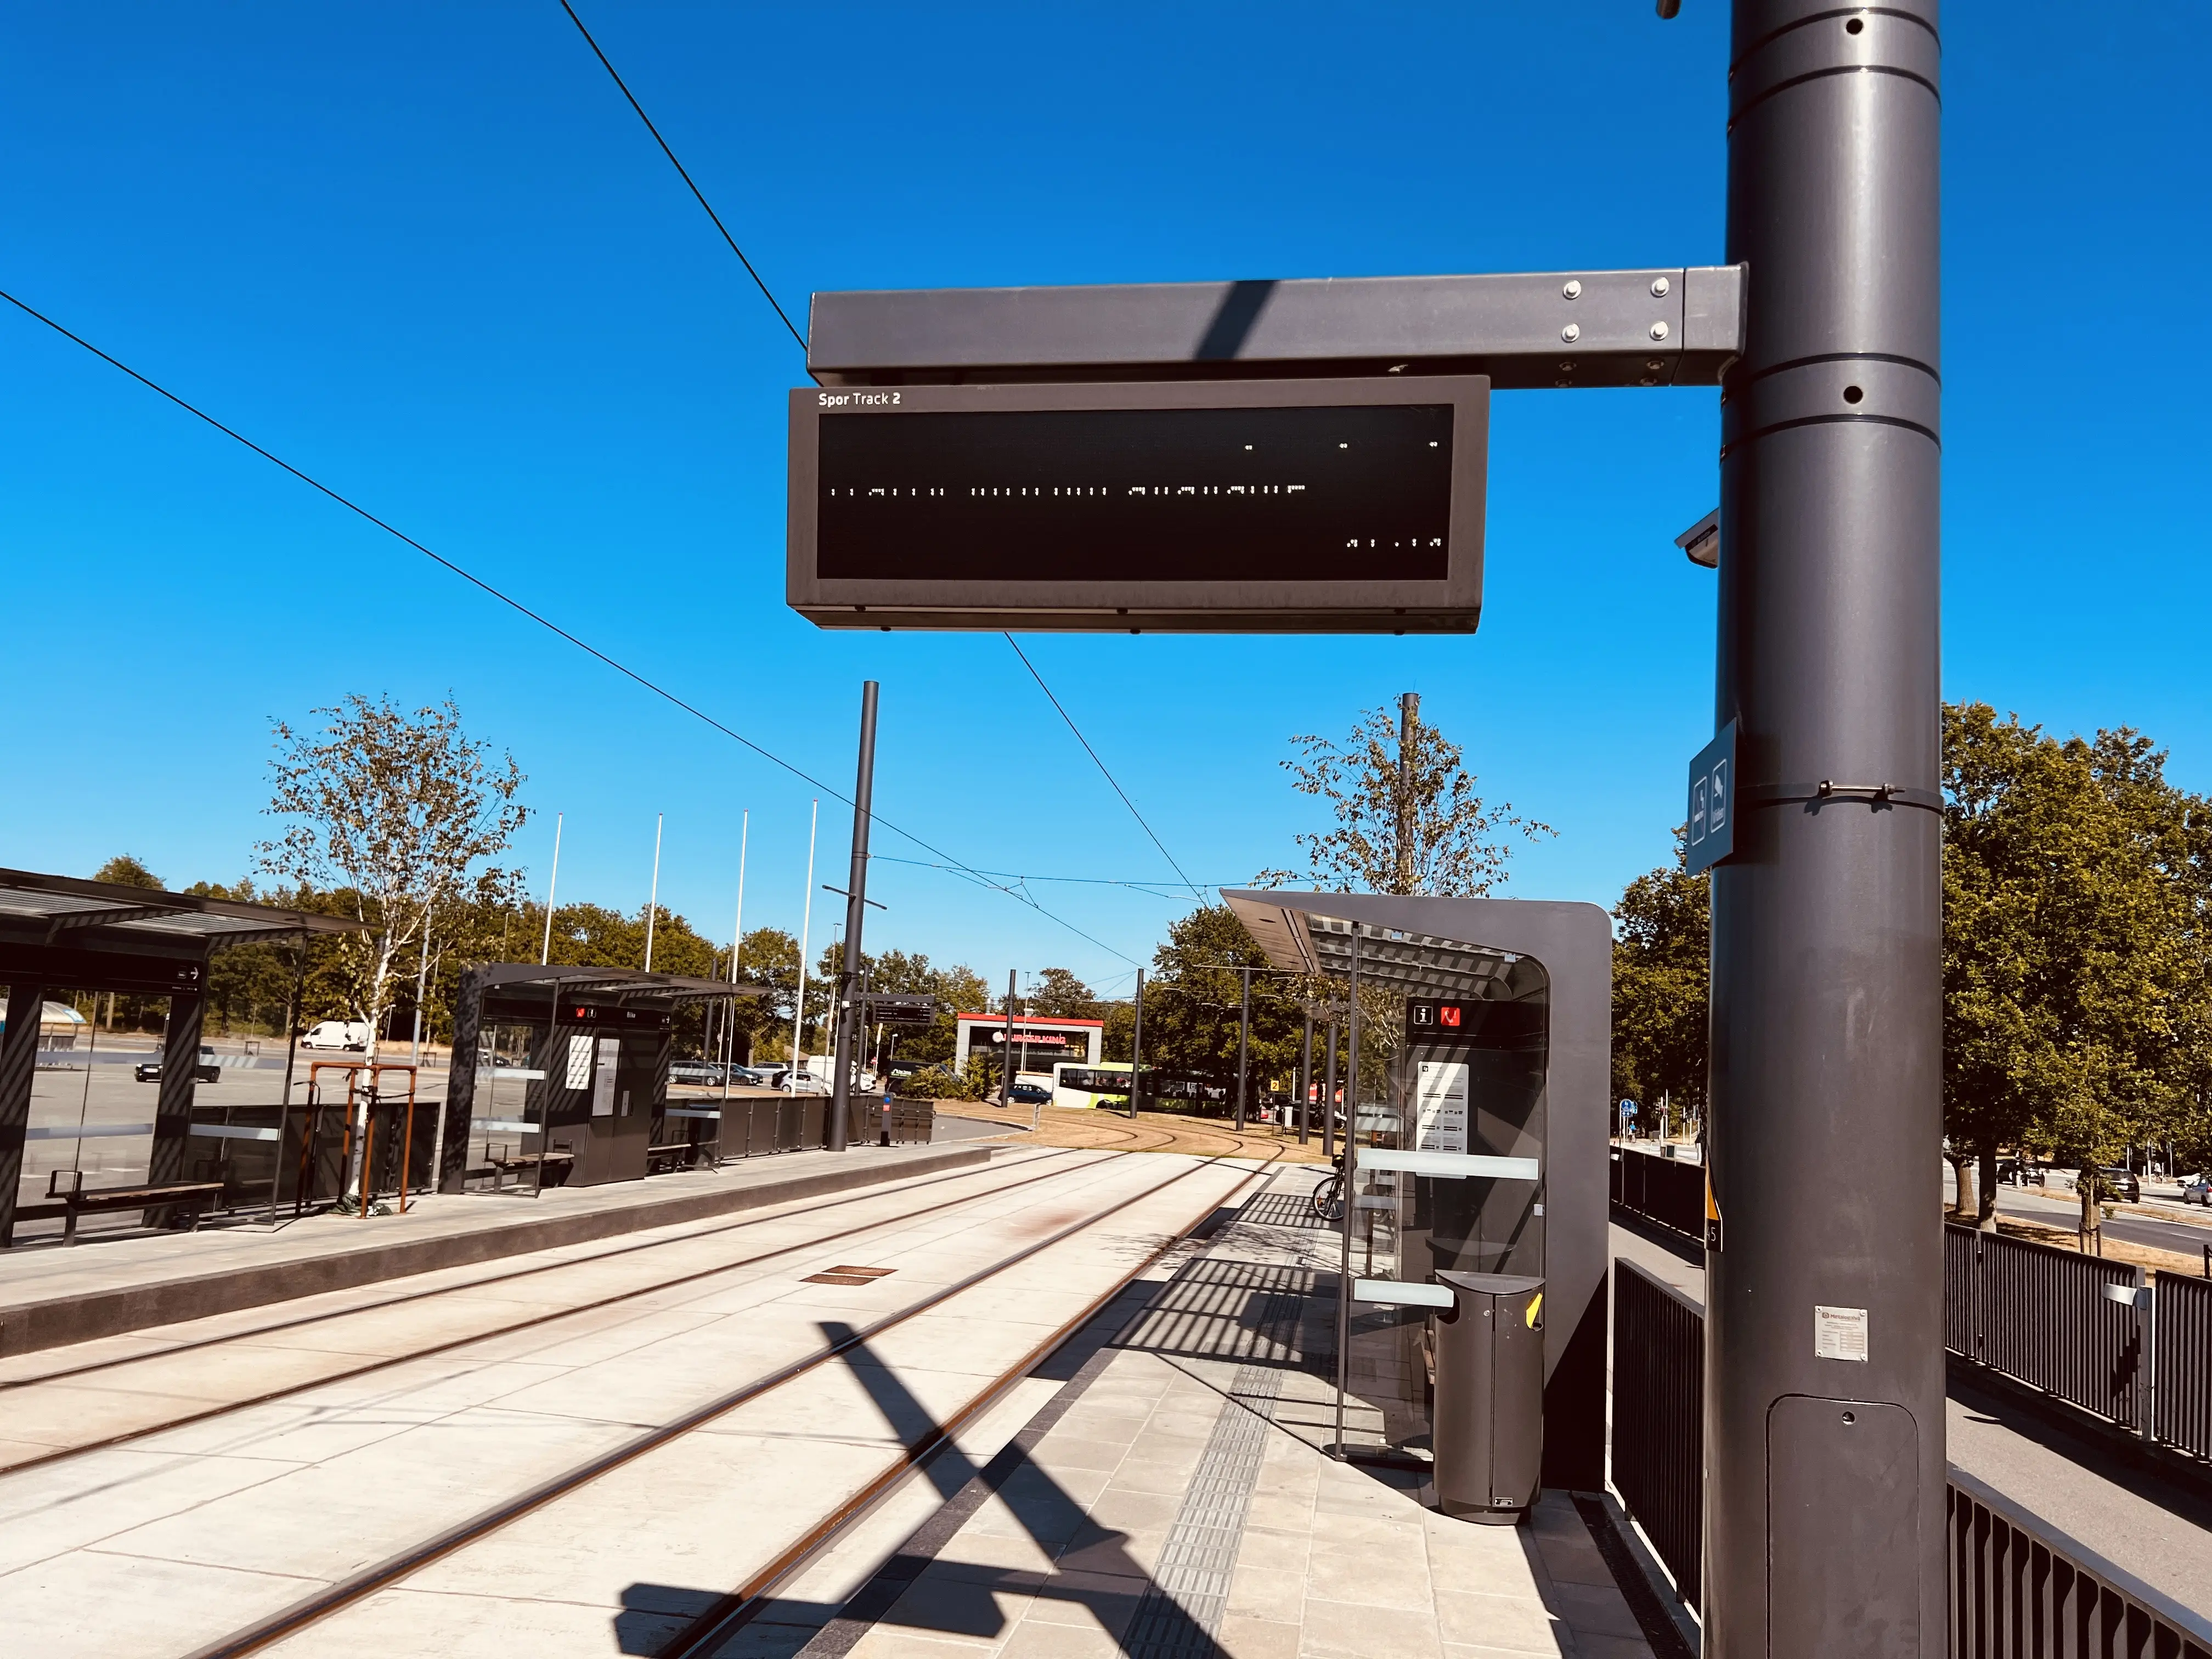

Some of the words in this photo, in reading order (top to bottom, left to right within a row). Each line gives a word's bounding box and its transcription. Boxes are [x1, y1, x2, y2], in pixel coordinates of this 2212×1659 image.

[819, 392, 850, 408] Spor
[852, 392, 889, 405] Track
[893, 392, 901, 404] 2
[1042, 1035, 1066, 1045] KING
